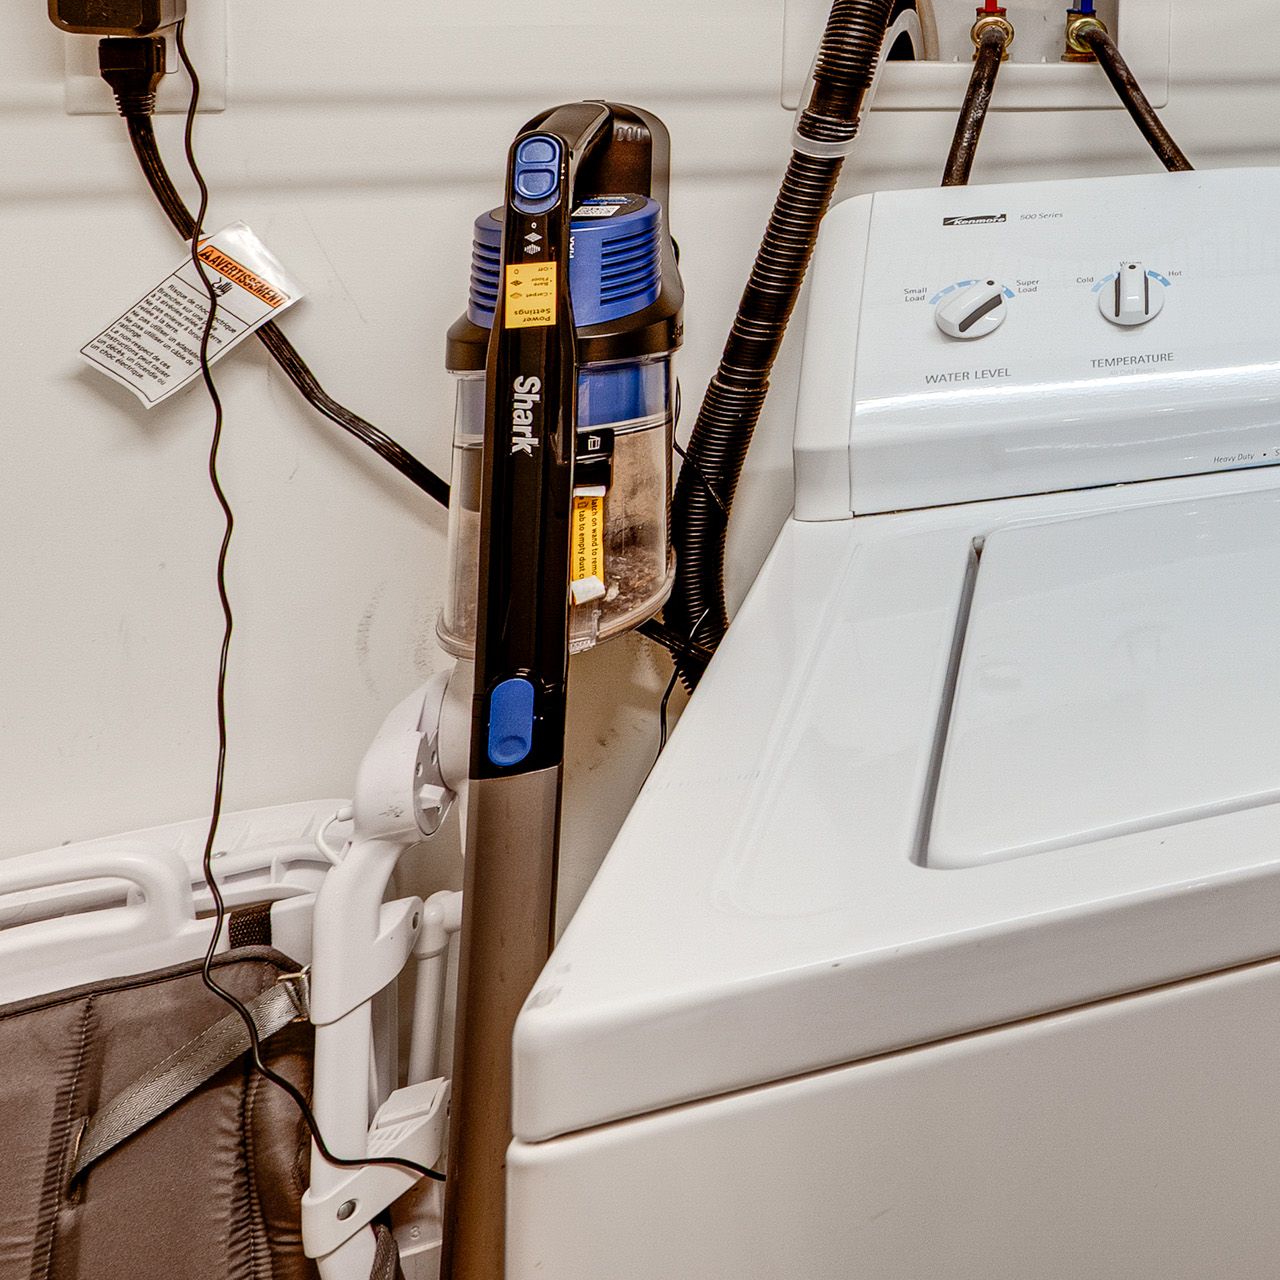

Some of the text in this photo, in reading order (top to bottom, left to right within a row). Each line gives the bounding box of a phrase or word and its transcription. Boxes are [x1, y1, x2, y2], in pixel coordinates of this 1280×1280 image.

[952, 211, 1064, 226] Kenmore Series
[206, 252, 287, 307] AVERTISSEMENT
[1016, 279, 1040, 288] Super
[1075, 276, 1094, 285] Cold
[903, 287, 928, 296] Small
[904, 294, 926, 303] Load
[1018, 285, 1038, 294] Load
[156, 287, 204, 321] Brancher sur une
[166, 284, 210, 314] Risque de choc
[151, 304, 164, 314] pas
[513, 307, 551, 315] Settings
[130, 322, 144, 331] pas
[142, 329, 164, 344] utiliser
[137, 315, 170, 337] pas utiliser
[98, 347, 116, 360] choc
[103, 331, 171, 379] instructions peut causer
[117, 332, 161, 362] non-respect de
[1090, 352, 1175, 369] TEMPERATURE
[132, 361, 159, 379] incendie
[925, 367, 1012, 385] WATER LEVEL
[512, 376, 542, 457] Shark
[1212, 451, 1255, 464] Heavy Duty
[590, 497, 600, 556] latch on wand to
[576, 510, 587, 572] tab to empty dust
